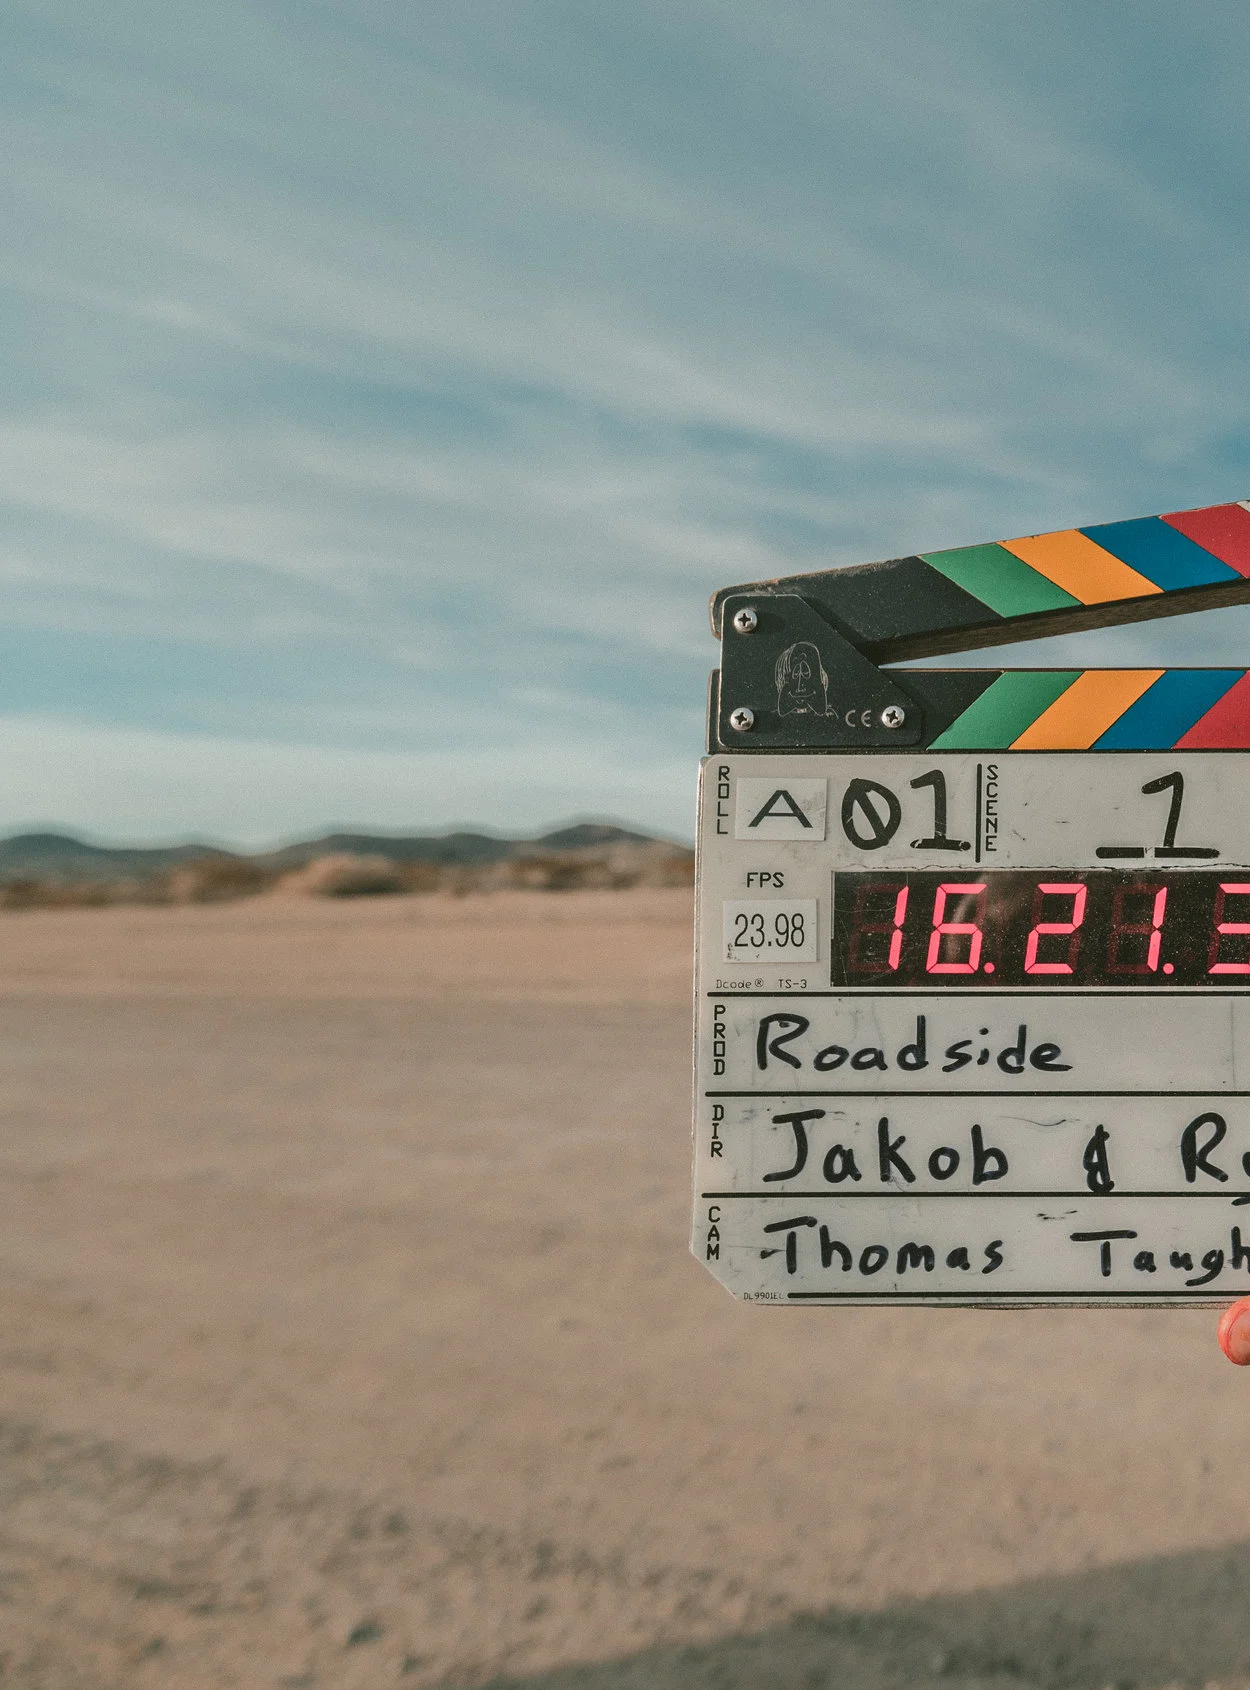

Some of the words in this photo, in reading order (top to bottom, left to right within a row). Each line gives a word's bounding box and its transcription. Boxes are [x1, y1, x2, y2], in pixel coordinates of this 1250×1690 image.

[717, 766, 729, 834] ROLL
[749, 790, 813, 828] A
[986, 765, 998, 851] SCENE
[747, 872, 784, 888] FPS
[733, 913, 805, 949] 23.98
[778, 979, 808, 989] TS-3
[713, 1005, 725, 1075] PROD
[757, 1013, 1073, 1074] Roadside
[711, 1105, 724, 1157] DIR
[763, 1109, 1008, 1185] Jakob
[1083, 1124, 1114, 1192] &
[707, 1206, 720, 1260] CAM
[760, 1216, 1003, 1275] Thomas
